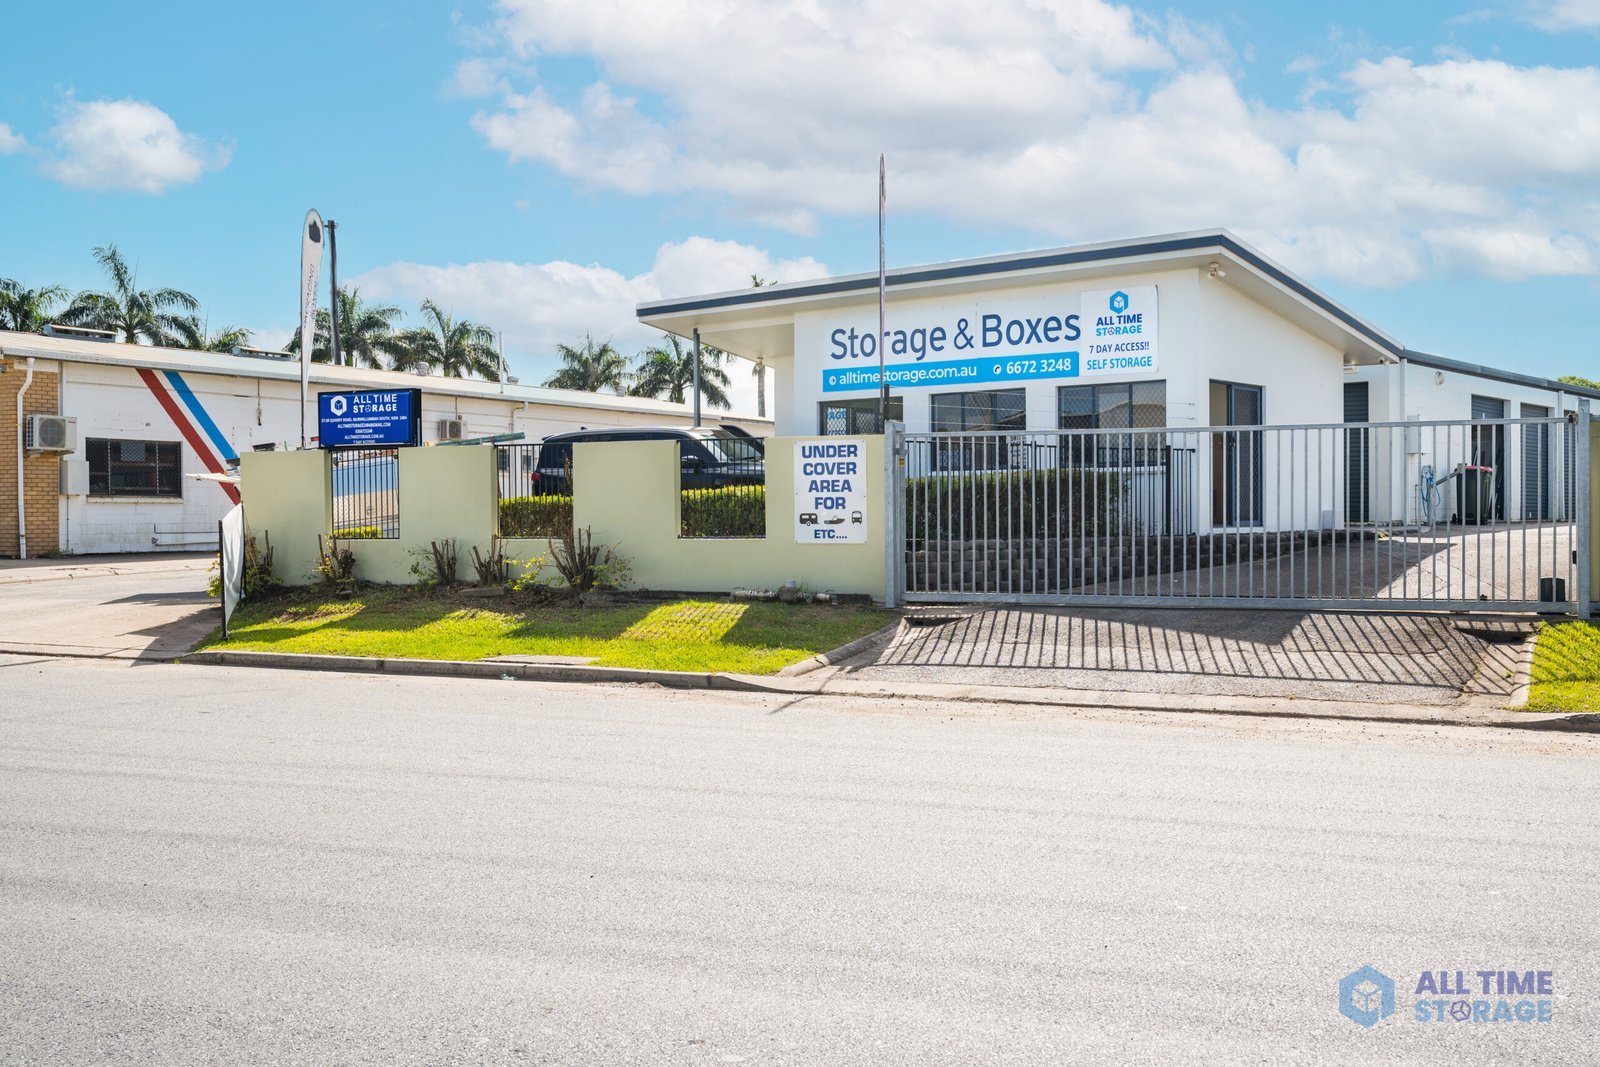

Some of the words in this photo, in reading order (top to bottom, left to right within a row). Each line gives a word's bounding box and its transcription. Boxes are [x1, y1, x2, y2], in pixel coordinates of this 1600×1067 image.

[1096, 316, 1115, 326] ALL
[1116, 313, 1143, 325] TIME
[953, 318, 975, 350] &
[982, 313, 1081, 348] Boxes
[1095, 325, 1142, 336] STORAGE
[1089, 345, 1094, 354] 7
[1096, 344, 1113, 354] DAY
[1114, 341, 1150, 352] ACCESS!!
[1086, 359, 1108, 370] SELF
[1109, 356, 1152, 369] STORAGE
[839, 366, 977, 385] alltimestorage.com.au
[1006, 360, 1037, 374] 6672
[1040, 358, 1071, 372] 3248
[353, 395, 372, 403] ALL
[374, 394, 397, 403] TIME
[353, 403, 397, 413] STORAGE
[801, 444, 858, 458] UNDER
[803, 462, 857, 476] COVER
[808, 479, 852, 493] AREA
[814, 496, 846, 510] FOR
[814, 529, 848, 539] ETC....
